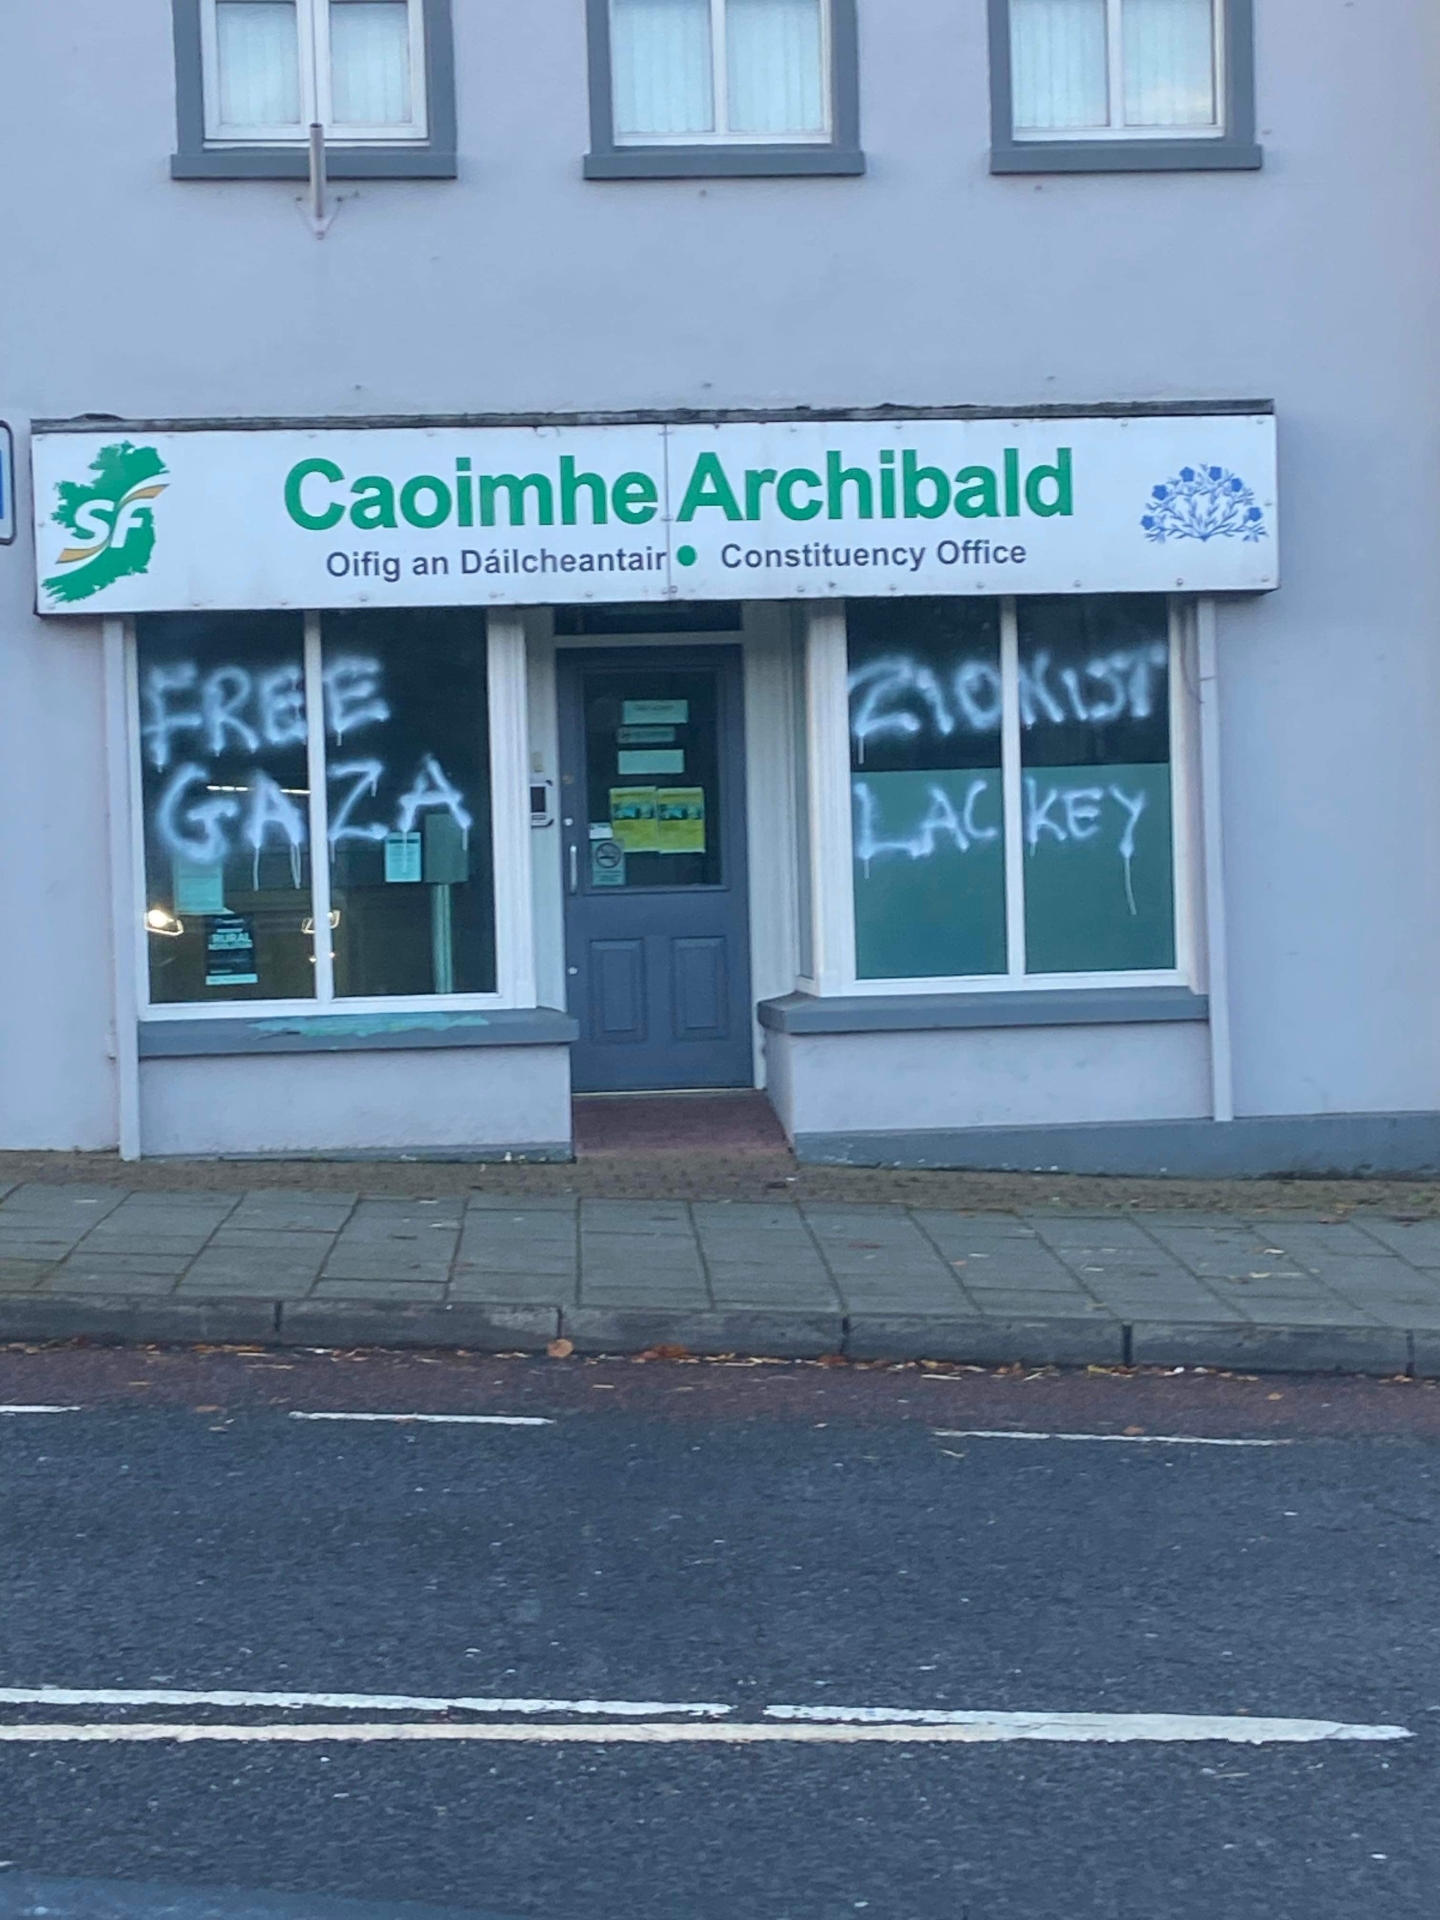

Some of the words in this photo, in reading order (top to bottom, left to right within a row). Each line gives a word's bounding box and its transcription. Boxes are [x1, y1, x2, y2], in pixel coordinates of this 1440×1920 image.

[284, 456, 659, 531] Caoimhe
[676, 447, 1074, 522] Archibald
[326, 551, 400, 582] Oifig
[412, 556, 449, 576] an
[461, 547, 666, 575] Dáilcheantair
[721, 541, 926, 572] Constituency
[937, 540, 1027, 565] Office
[143, 655, 390, 770] FREE
[156, 752, 474, 866] GAZA
[853, 776, 1146, 860] LACKEY
